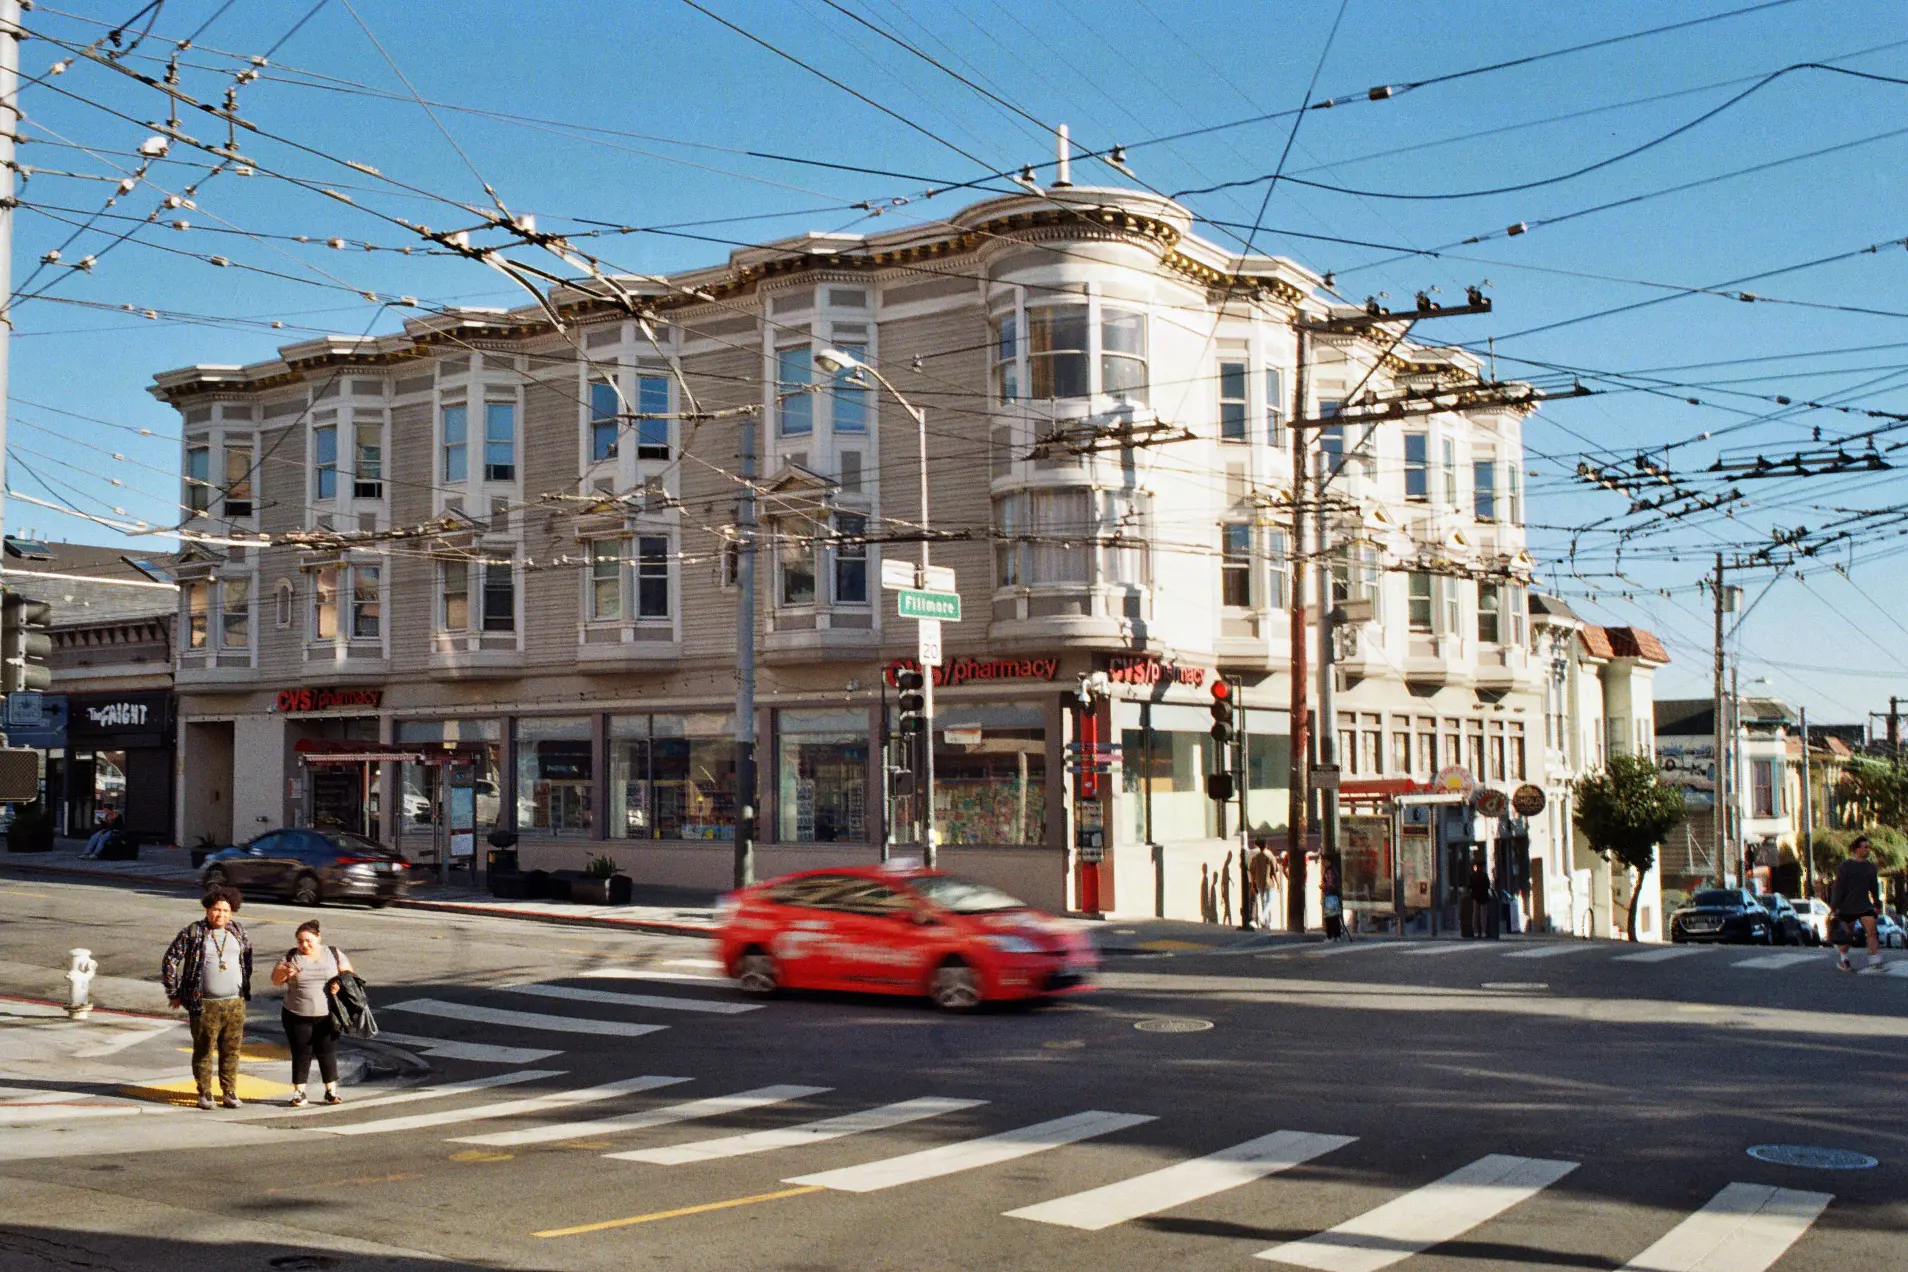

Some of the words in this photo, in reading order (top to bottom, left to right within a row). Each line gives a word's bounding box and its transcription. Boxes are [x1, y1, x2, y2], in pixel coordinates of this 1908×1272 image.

[904, 595, 955, 615] Fillmore
[923, 643, 938, 660] 20
[885, 656, 1059, 688] C/pharmacy
[277, 688, 380, 711] CVS/pharmacy
